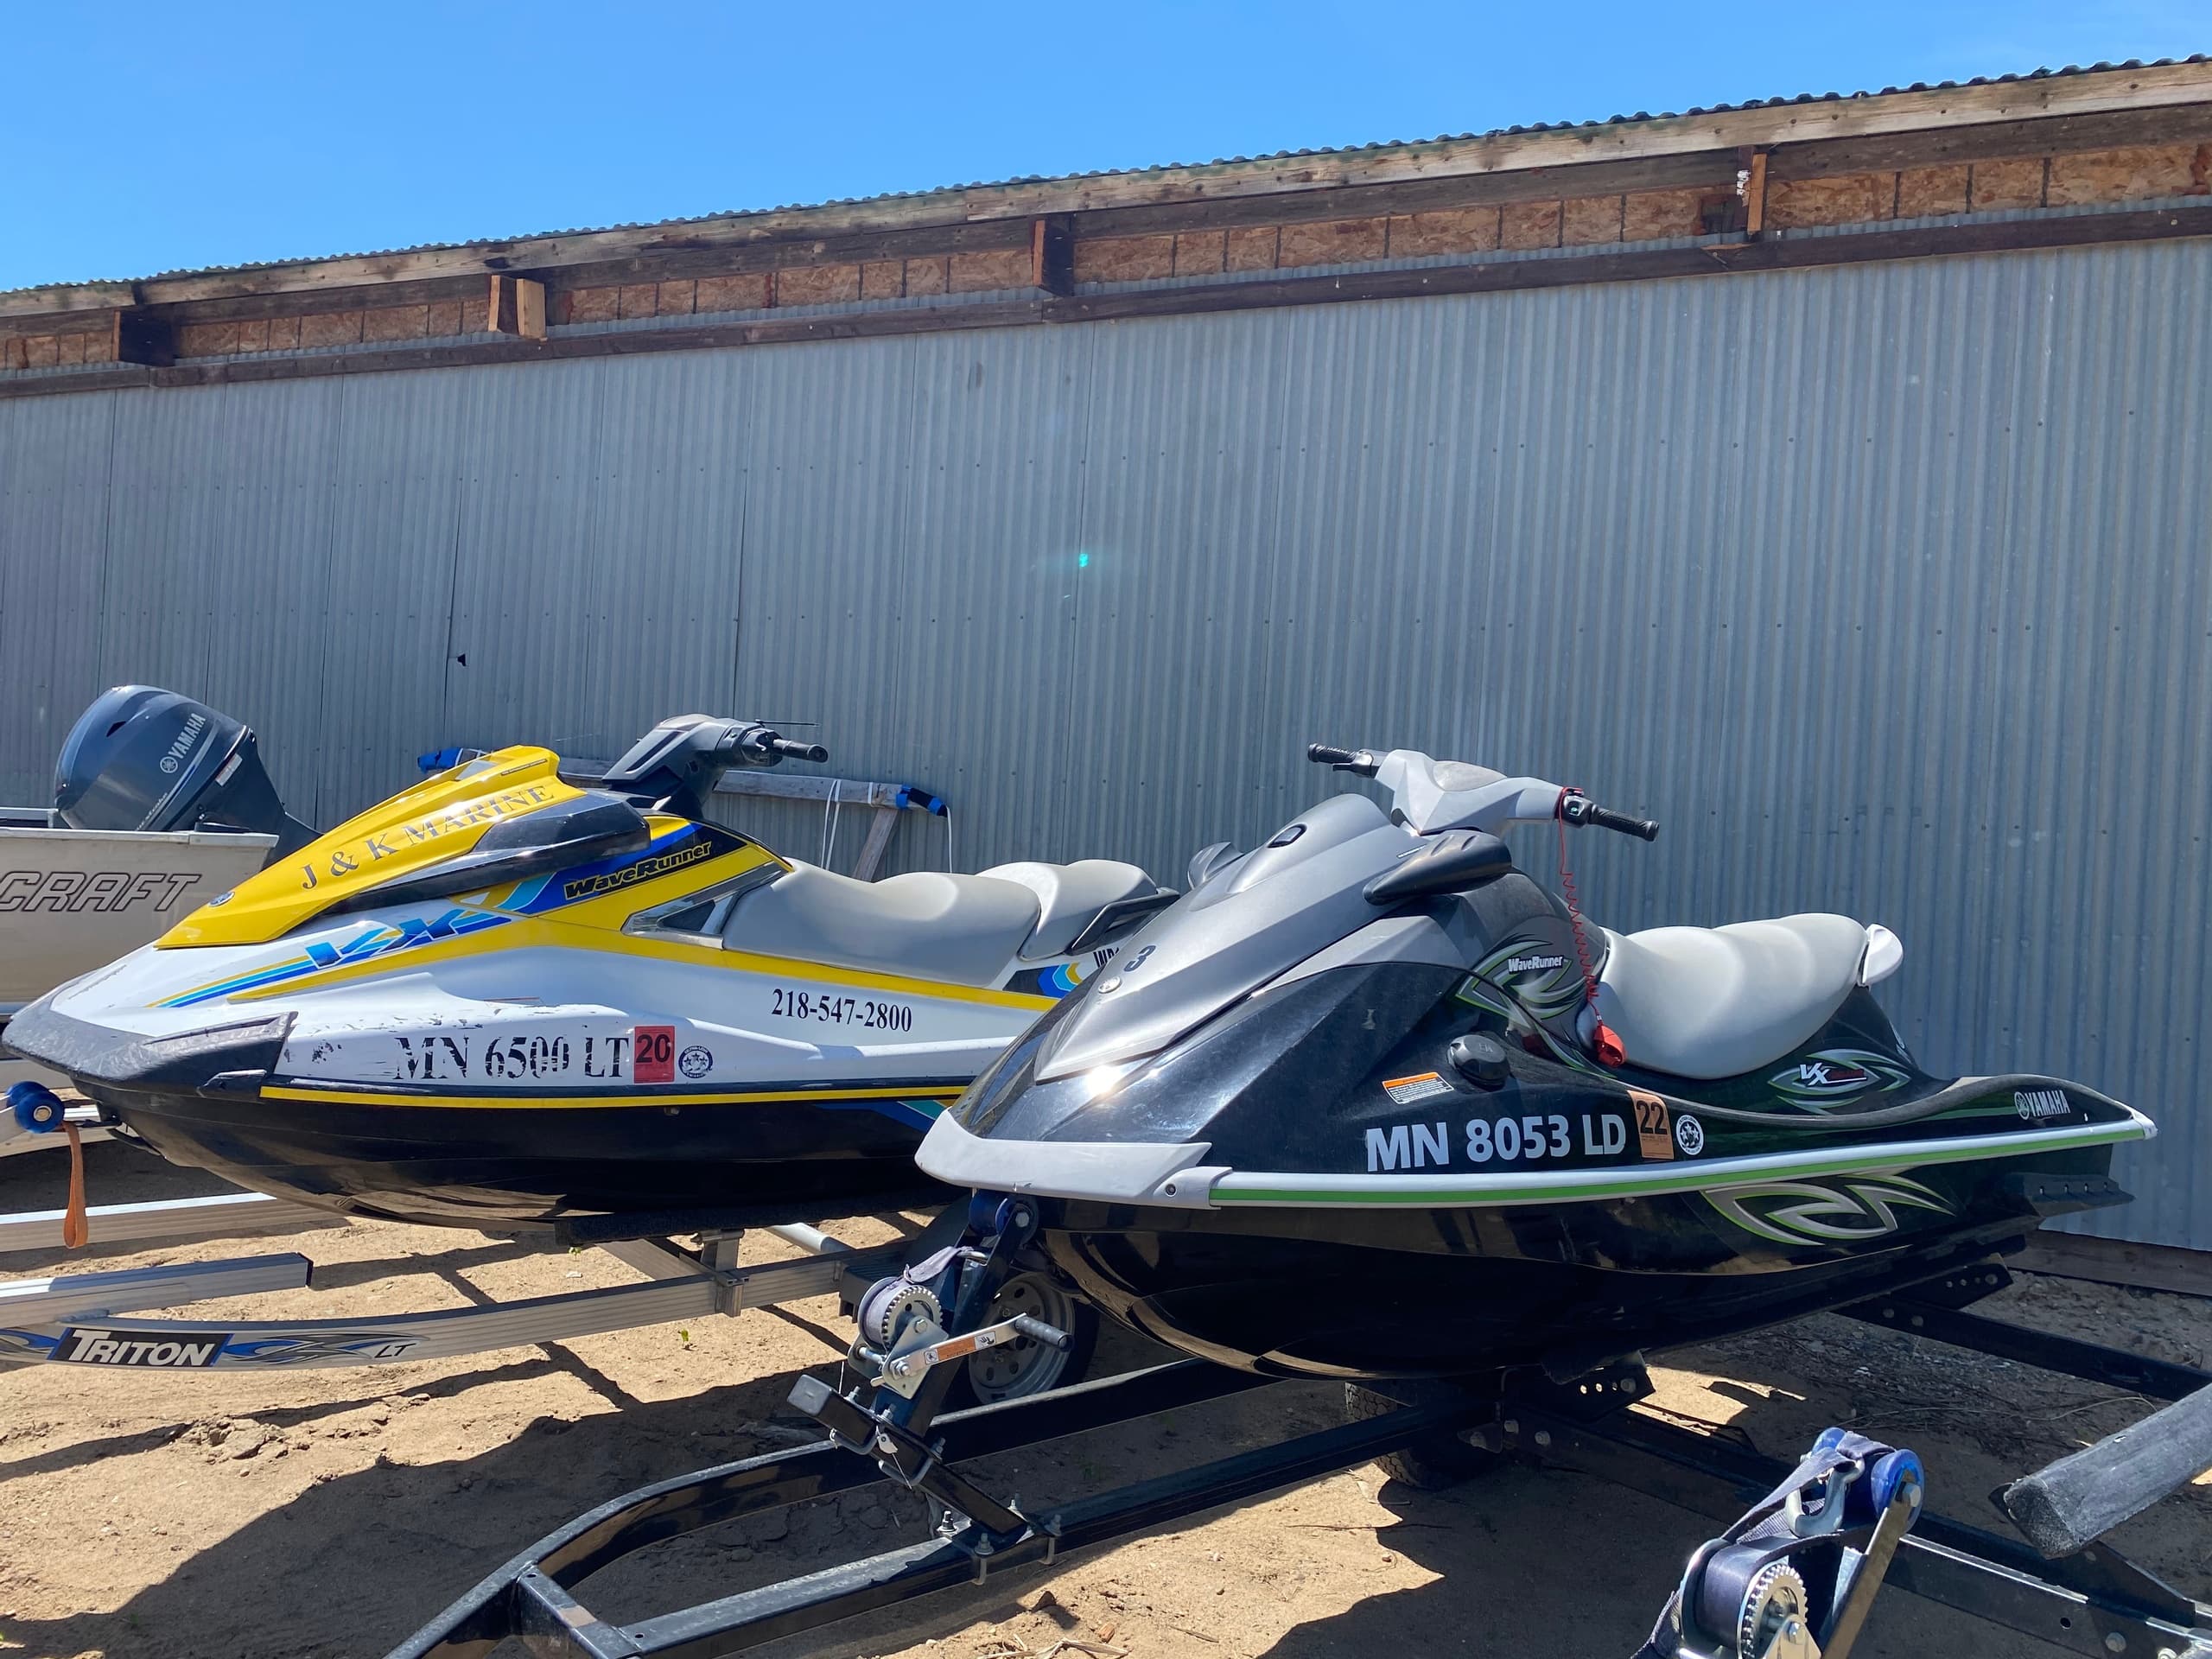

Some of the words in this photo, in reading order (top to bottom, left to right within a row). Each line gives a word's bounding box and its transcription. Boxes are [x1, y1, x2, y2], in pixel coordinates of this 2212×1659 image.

[168, 713, 207, 760] YAMAHA
[302, 864, 317, 889] J
[330, 851, 359, 876] &
[365, 833, 399, 861] K
[404, 785, 554, 846] MARINE
[563, 841, 712, 900] WaveRunner
[0, 871, 202, 912] CRAFT
[1123, 945, 1156, 972] 3
[1508, 956, 1563, 972] WaveRunner
[772, 988, 912, 1032] 218-547-2800
[391, 1036, 468, 1079] MN
[585, 1036, 629, 1077] LT
[636, 1033, 671, 1063] 20
[1800, 1062, 1830, 1086] VX
[1636, 1100, 1668, 1135] 22
[2024, 1090, 2070, 1116] YAMAHA
[1367, 1122, 1450, 1173] MN
[1465, 1115, 1571, 1163] 8053
[1582, 1114, 1626, 1156] LD
[68, 1330, 215, 1367] TRITON
[373, 1343, 417, 1359] LT
